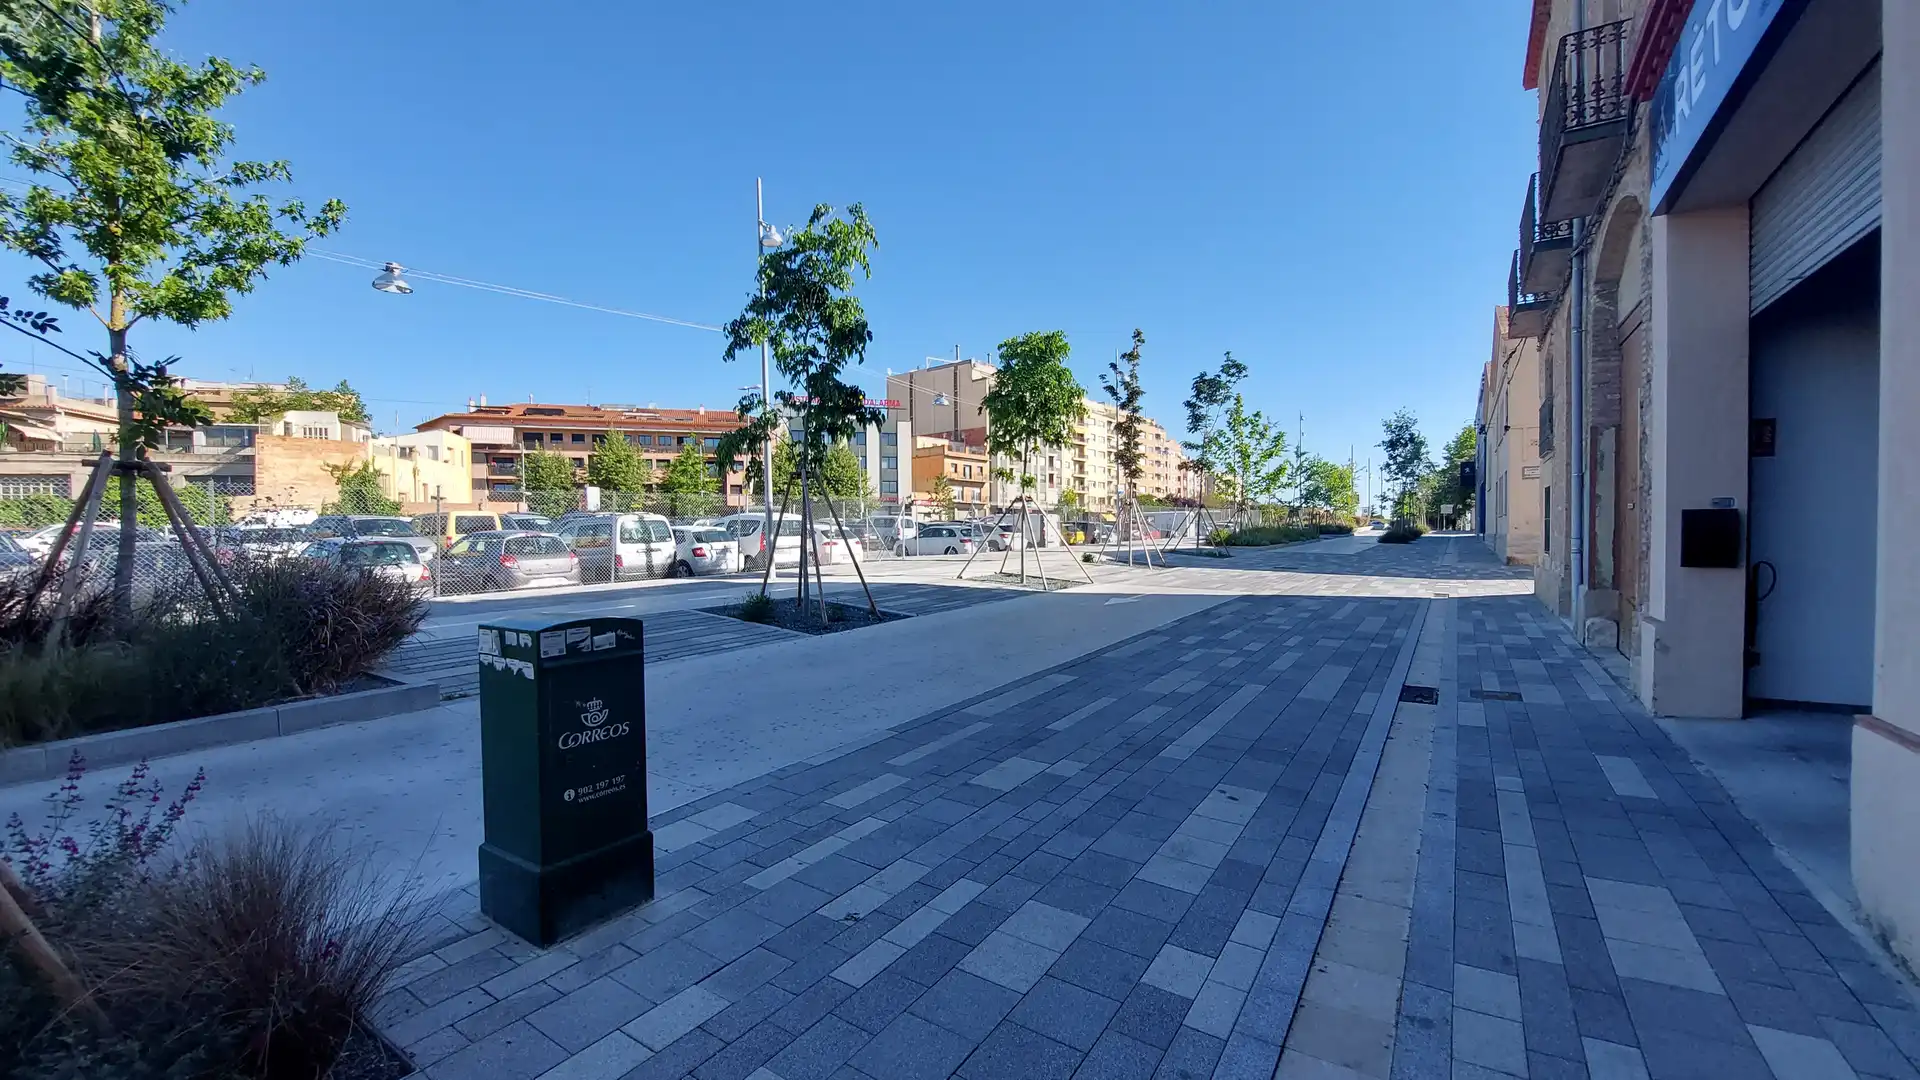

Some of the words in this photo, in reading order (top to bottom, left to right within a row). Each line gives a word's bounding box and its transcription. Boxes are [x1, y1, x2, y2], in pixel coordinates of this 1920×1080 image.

[558, 721, 630, 750] CORREOS
[577, 783, 626, 803] www.correos.es
[578, 784, 594, 796] 902
[595, 779, 610, 790] 197
[612, 774, 626, 785] 197
